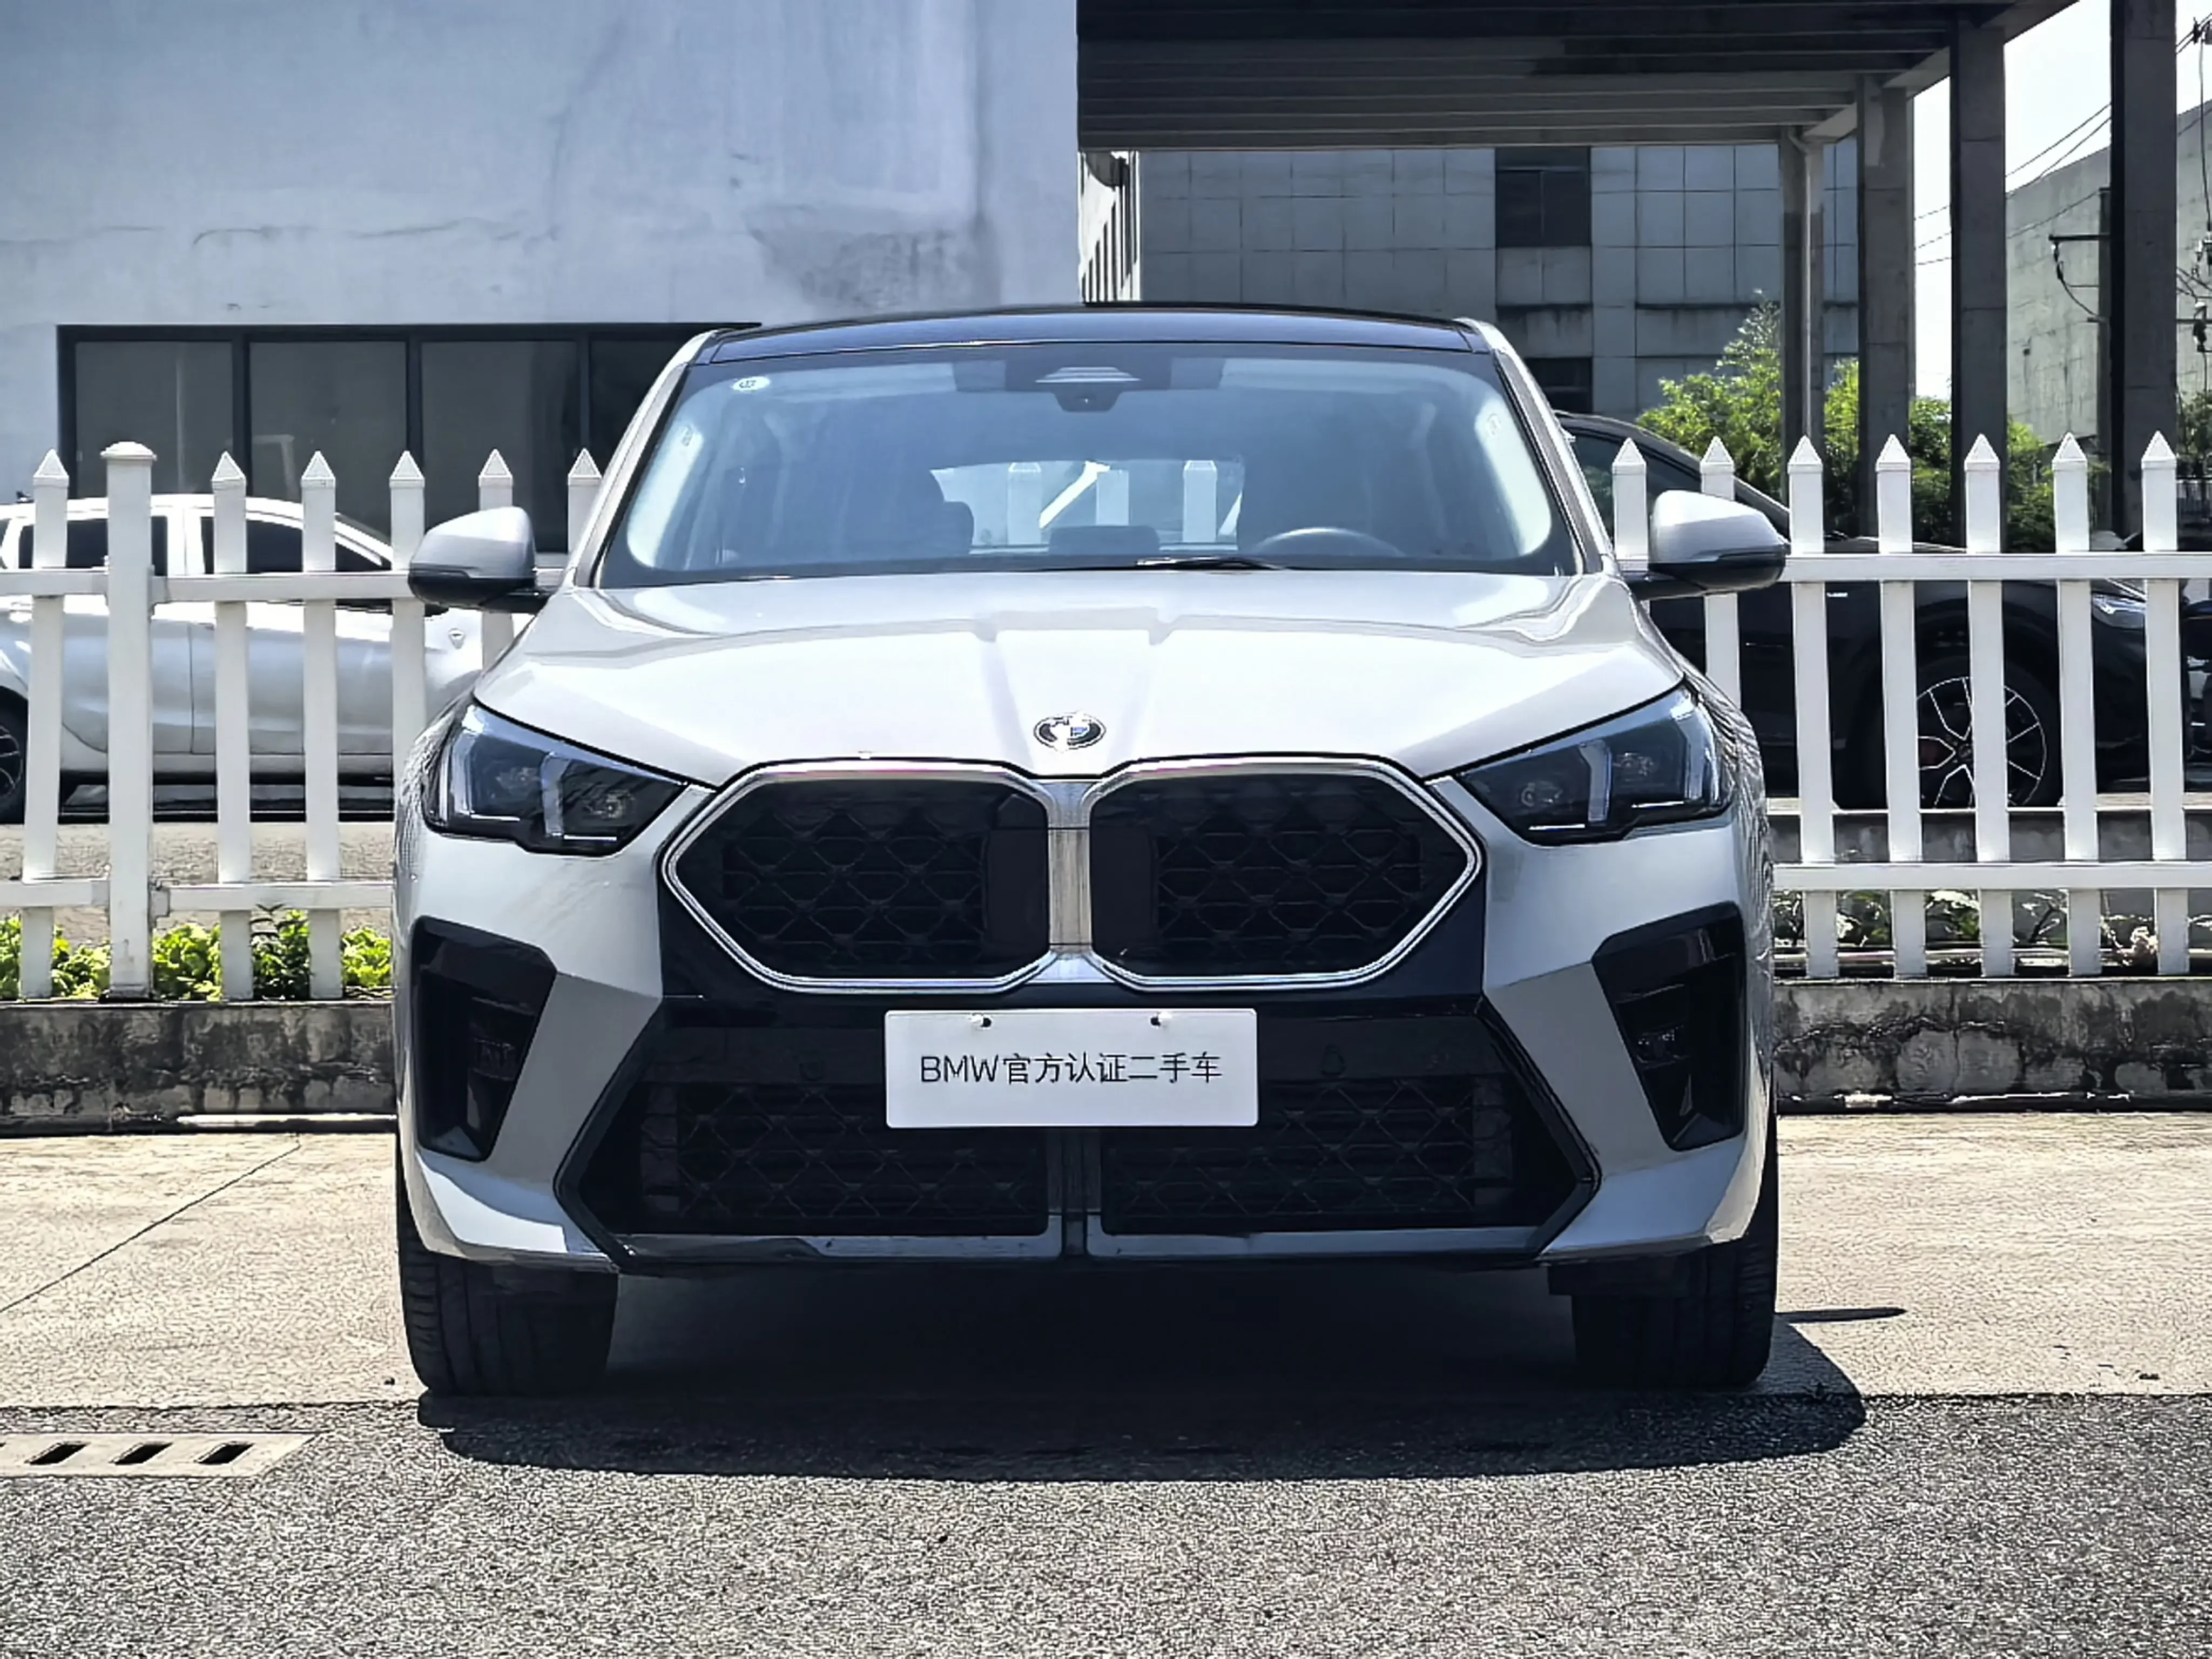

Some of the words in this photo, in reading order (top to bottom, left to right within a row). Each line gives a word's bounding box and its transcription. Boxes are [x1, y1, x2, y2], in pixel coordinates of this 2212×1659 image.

[920, 1051, 1223, 1085] BMW官方认证二手车
